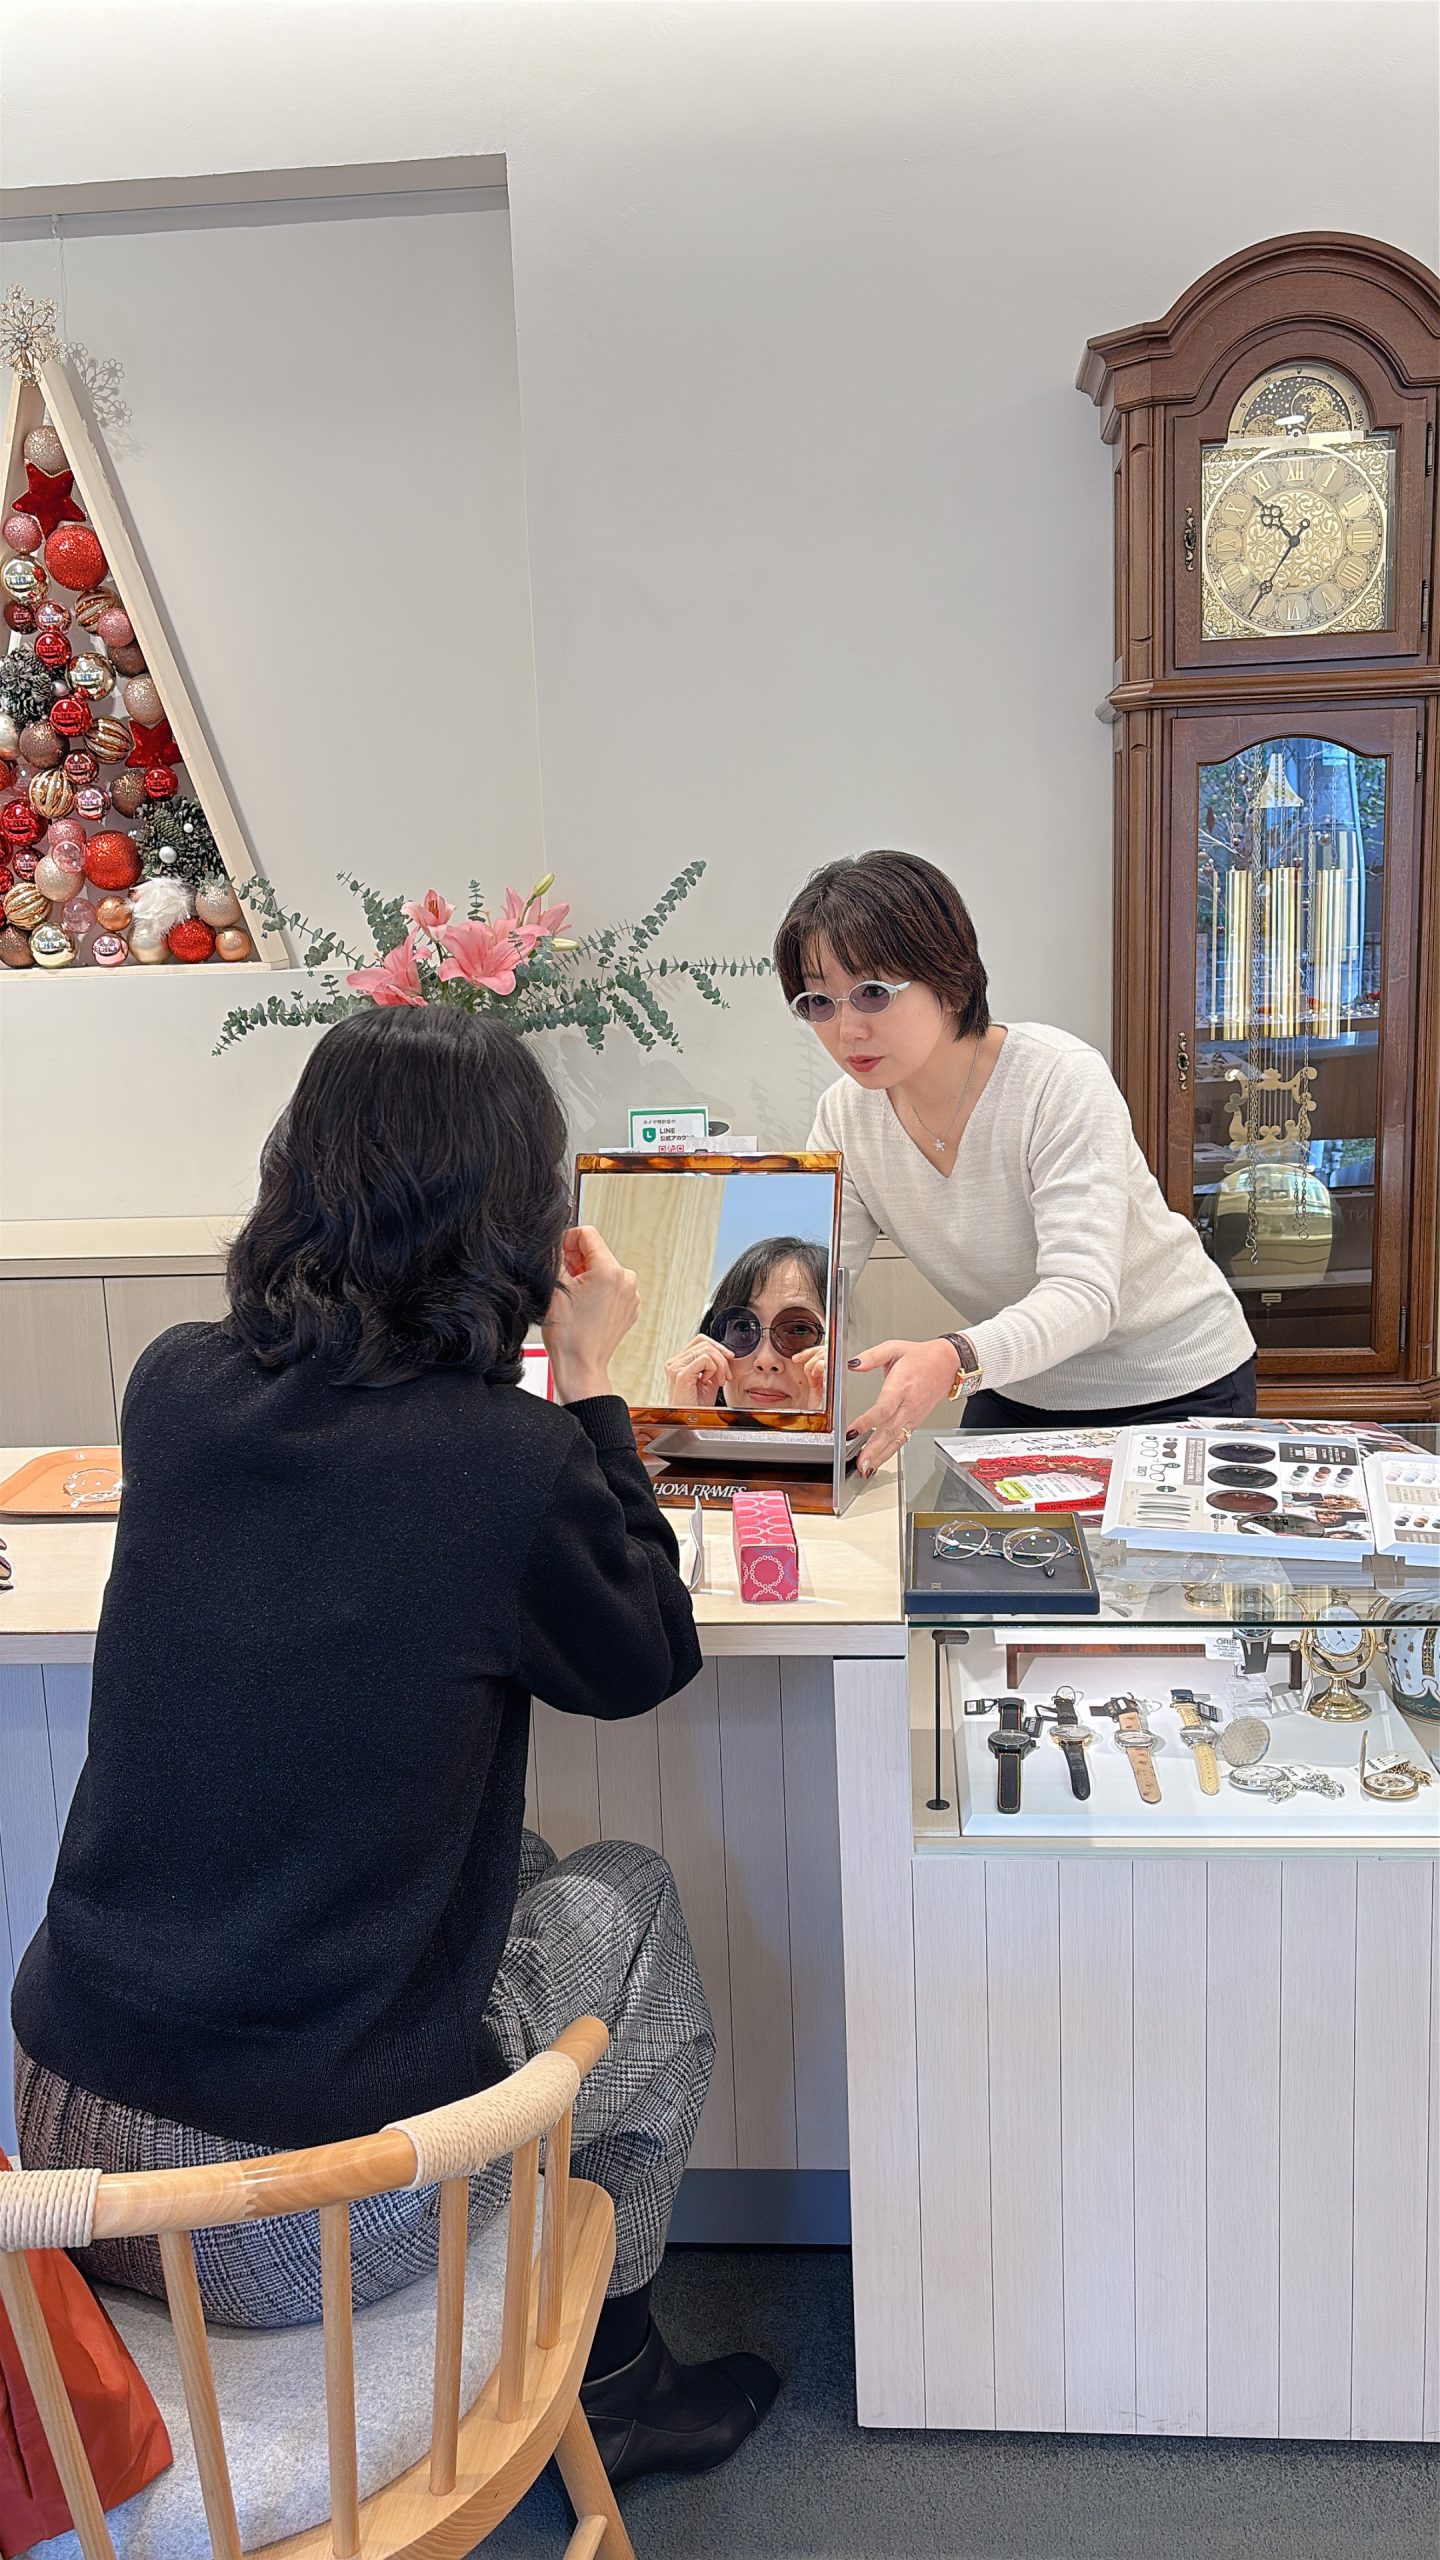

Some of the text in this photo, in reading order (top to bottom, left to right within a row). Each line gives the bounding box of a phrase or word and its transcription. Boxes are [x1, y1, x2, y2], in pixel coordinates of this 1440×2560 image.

[1286, 460, 1304, 481] XII
[1250, 470, 1272, 495] XI
[1352, 530, 1373, 544] III
[653, 1483, 689, 1496] HOYA
[1216, 1638, 1237, 1646] ORIS
